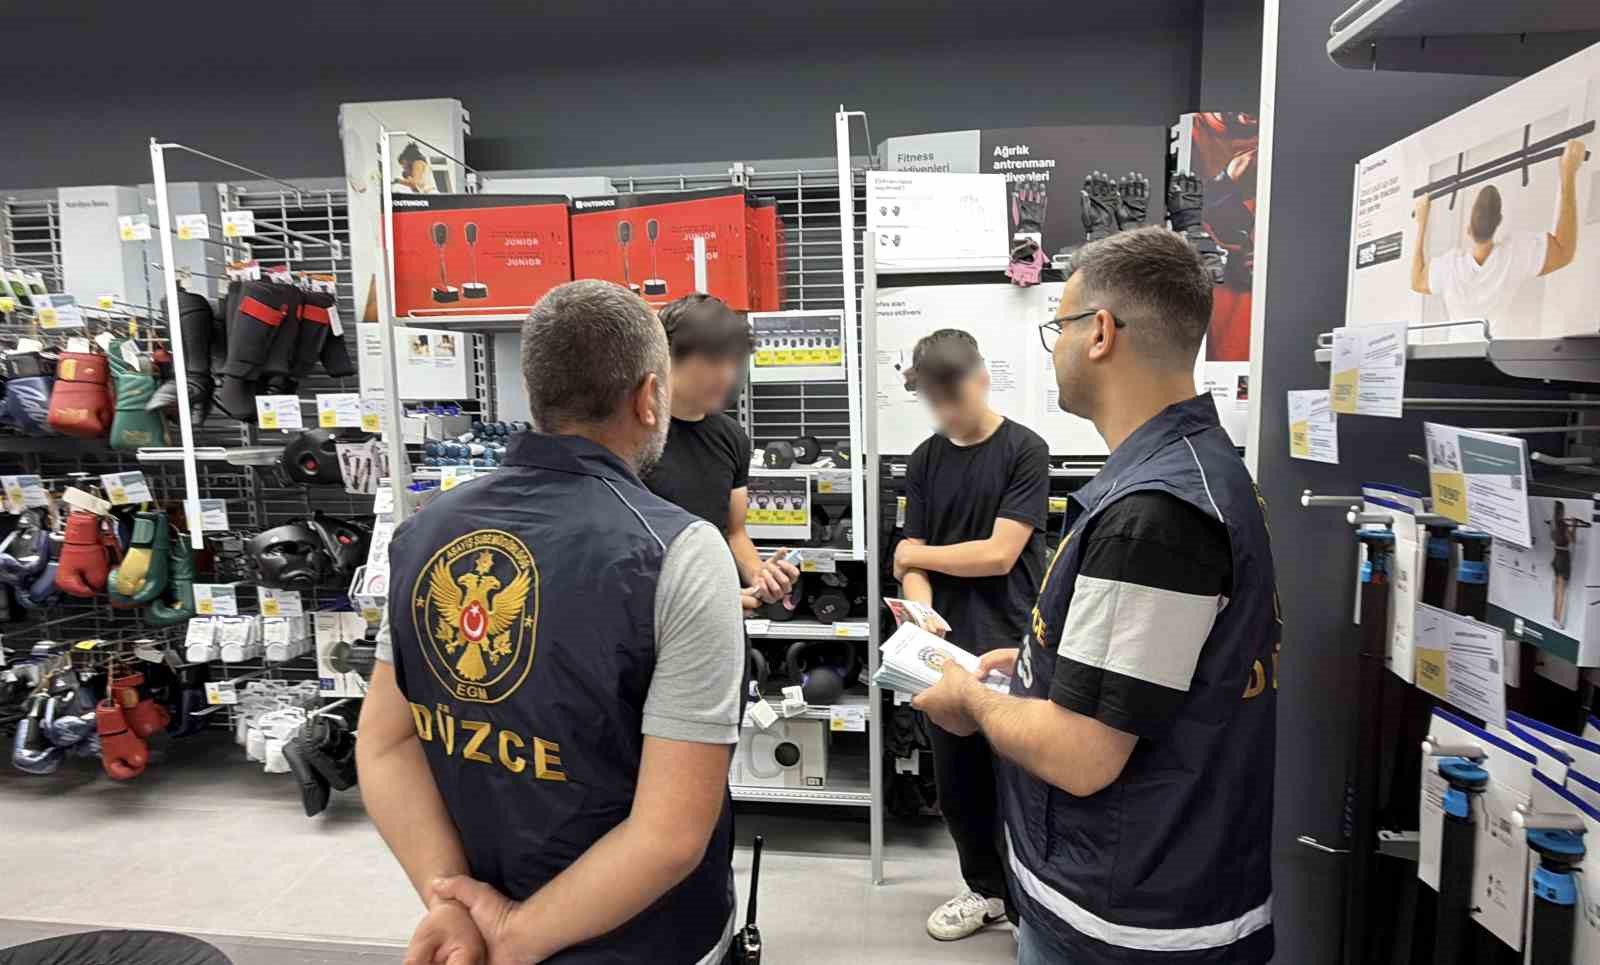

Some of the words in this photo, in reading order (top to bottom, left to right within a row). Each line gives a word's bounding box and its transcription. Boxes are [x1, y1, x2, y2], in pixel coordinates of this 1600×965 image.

[994, 145, 1030, 158] Ağırlık
[897, 152, 934, 163] Fitness
[993, 159, 1056, 170] antrenmanı
[504, 238, 539, 247] JUNIOR
[505, 257, 541, 267] JUNIOR
[685, 252, 718, 262] JUOR
[455, 684, 489, 700] EGM
[410, 701, 568, 782] DÜZCE
